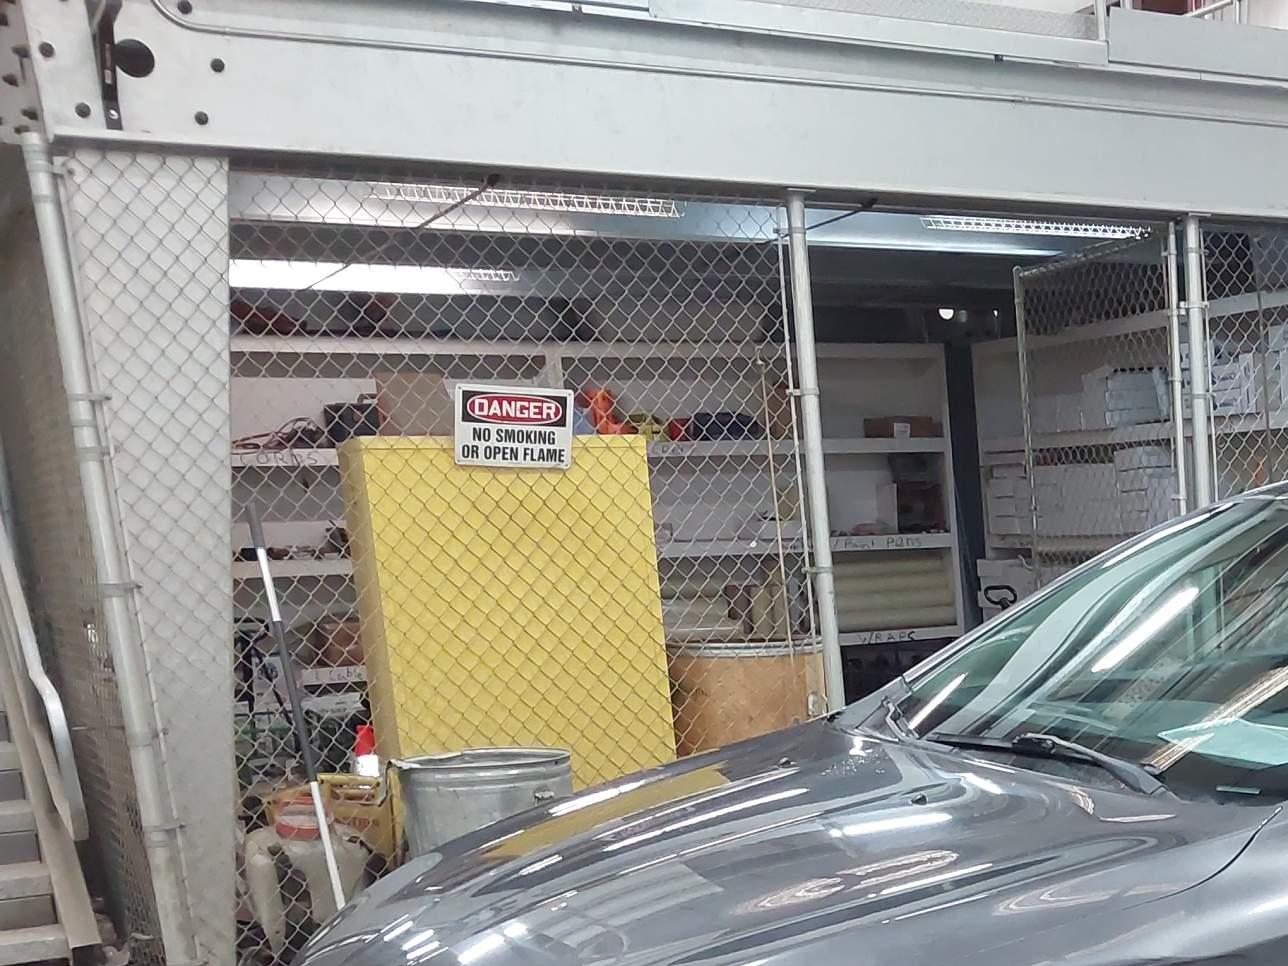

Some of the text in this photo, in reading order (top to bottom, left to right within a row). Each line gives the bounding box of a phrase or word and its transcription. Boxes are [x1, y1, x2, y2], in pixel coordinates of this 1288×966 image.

[474, 398, 556, 419] DANGER
[472, 427, 556, 445] NO SMOKING
[461, 444, 565, 463] OR OPEN FLAME
